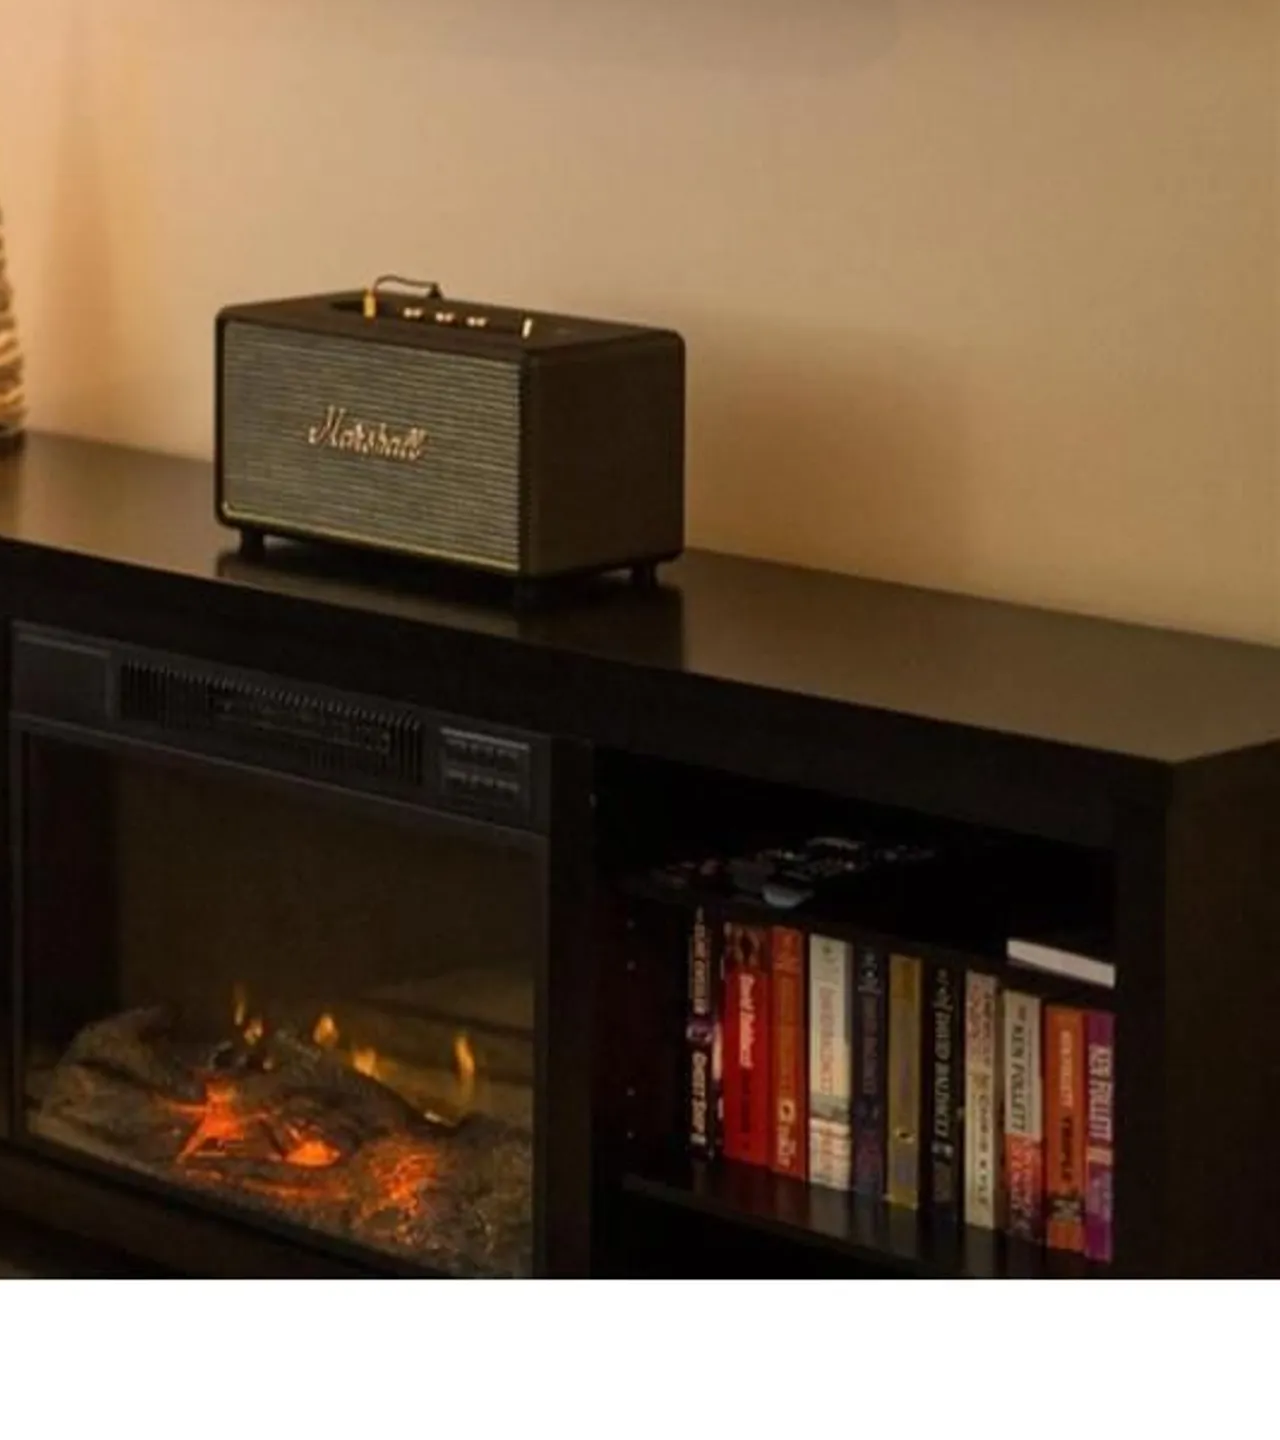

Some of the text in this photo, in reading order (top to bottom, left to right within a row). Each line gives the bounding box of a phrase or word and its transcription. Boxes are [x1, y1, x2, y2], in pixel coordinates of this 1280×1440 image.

[307, 405, 428, 462] Marshall
[1011, 1024, 1026, 1059] KEN
[1011, 1062, 1026, 1131] FOLLETT
